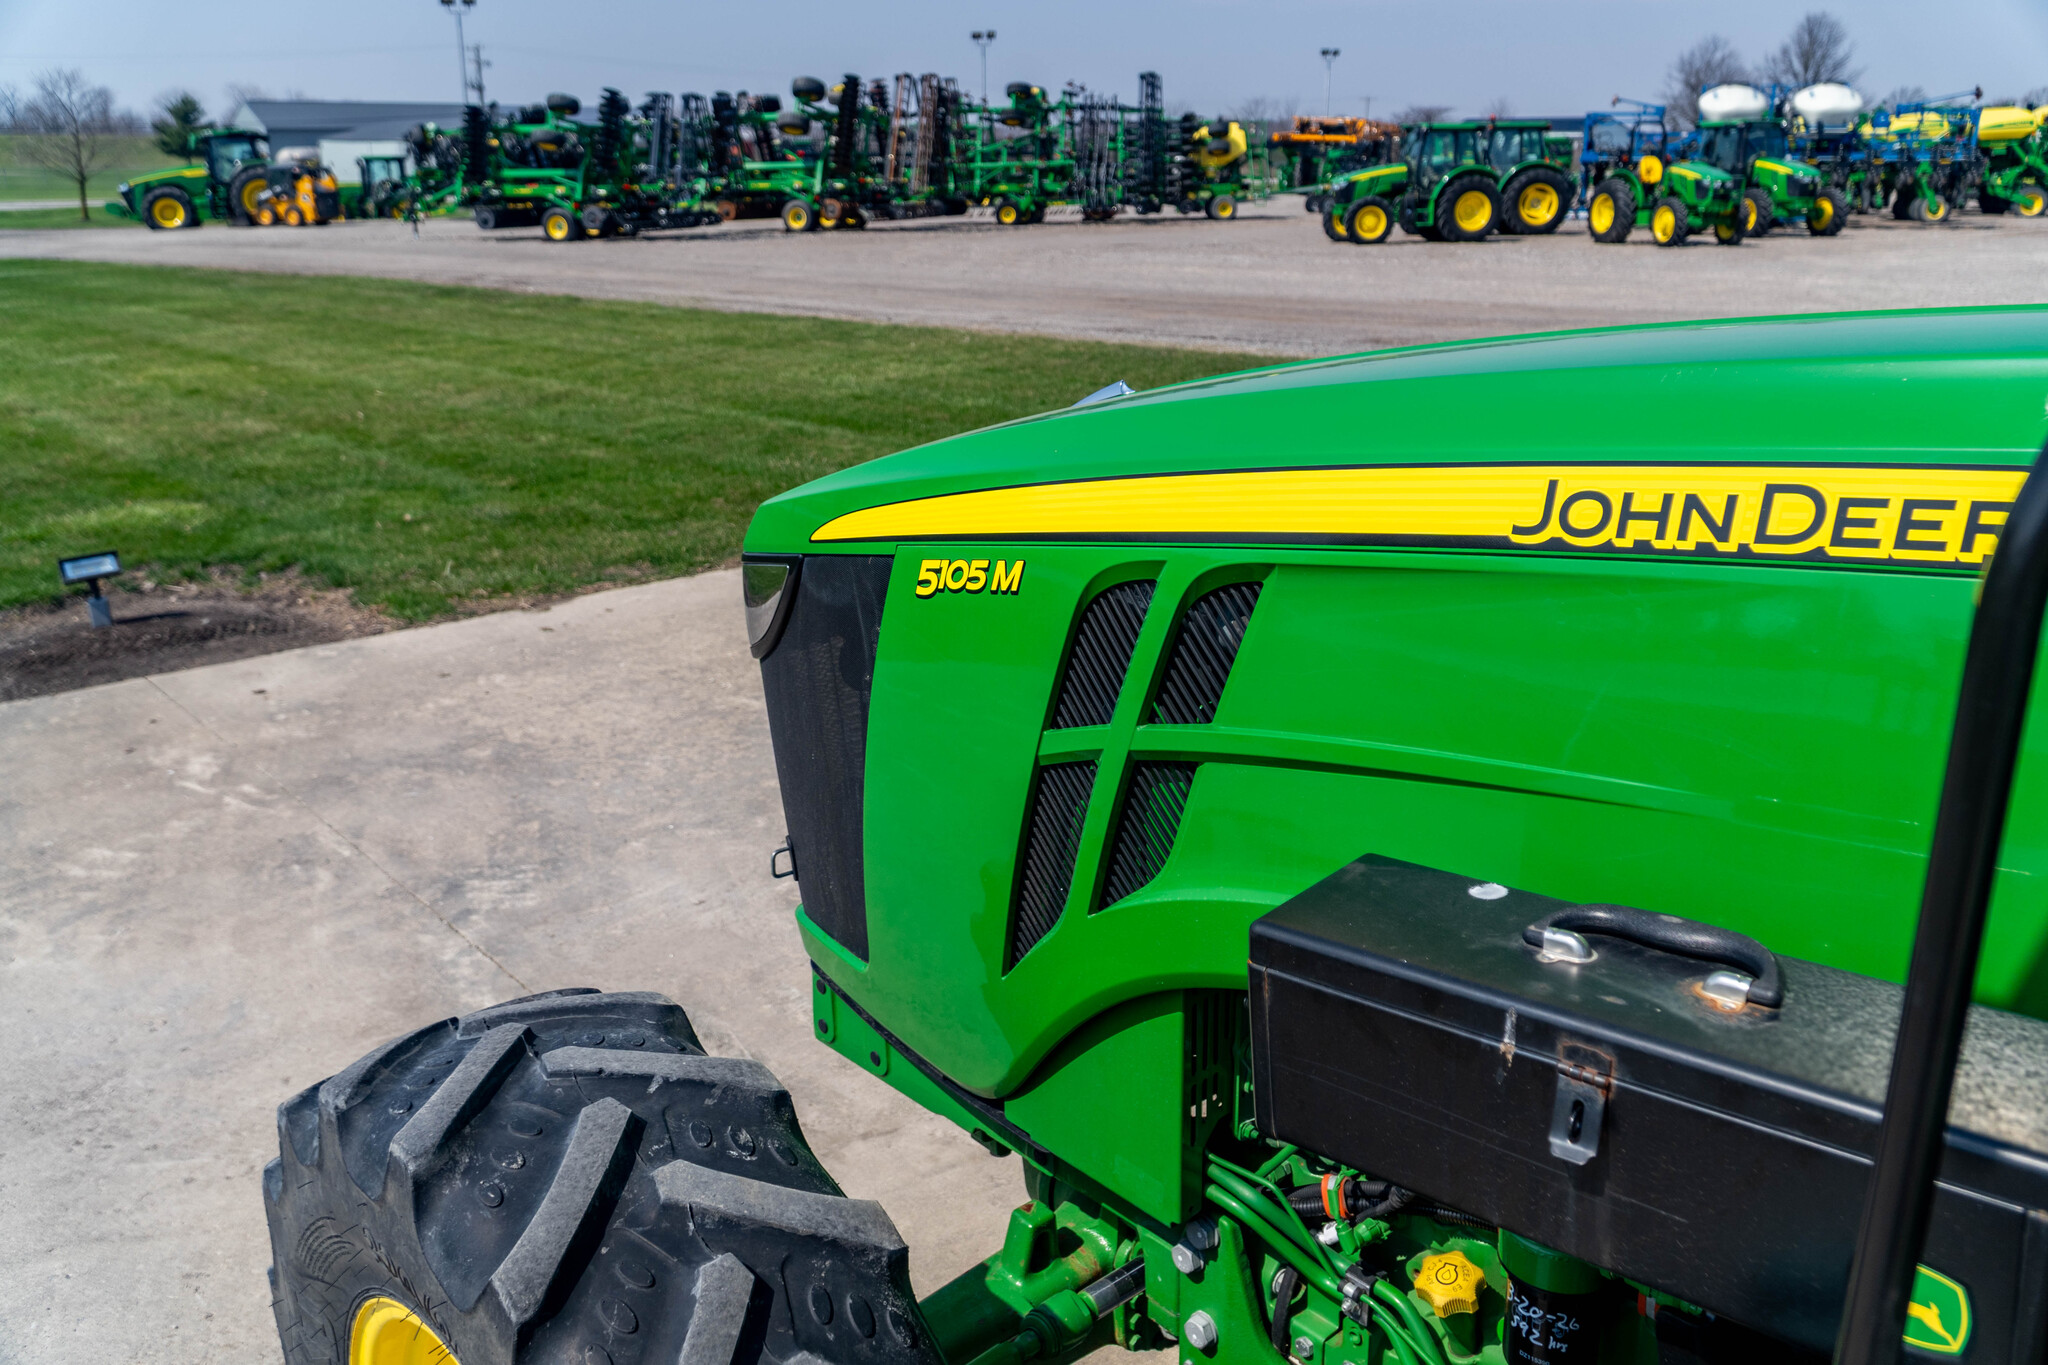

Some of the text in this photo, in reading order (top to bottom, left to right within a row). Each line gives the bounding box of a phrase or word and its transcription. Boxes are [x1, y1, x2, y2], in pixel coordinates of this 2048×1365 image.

[1510, 478, 2015, 556] JOHN DEER
[915, 559, 1026, 599] 5105 M
[1511, 1314, 1543, 1346] 592
